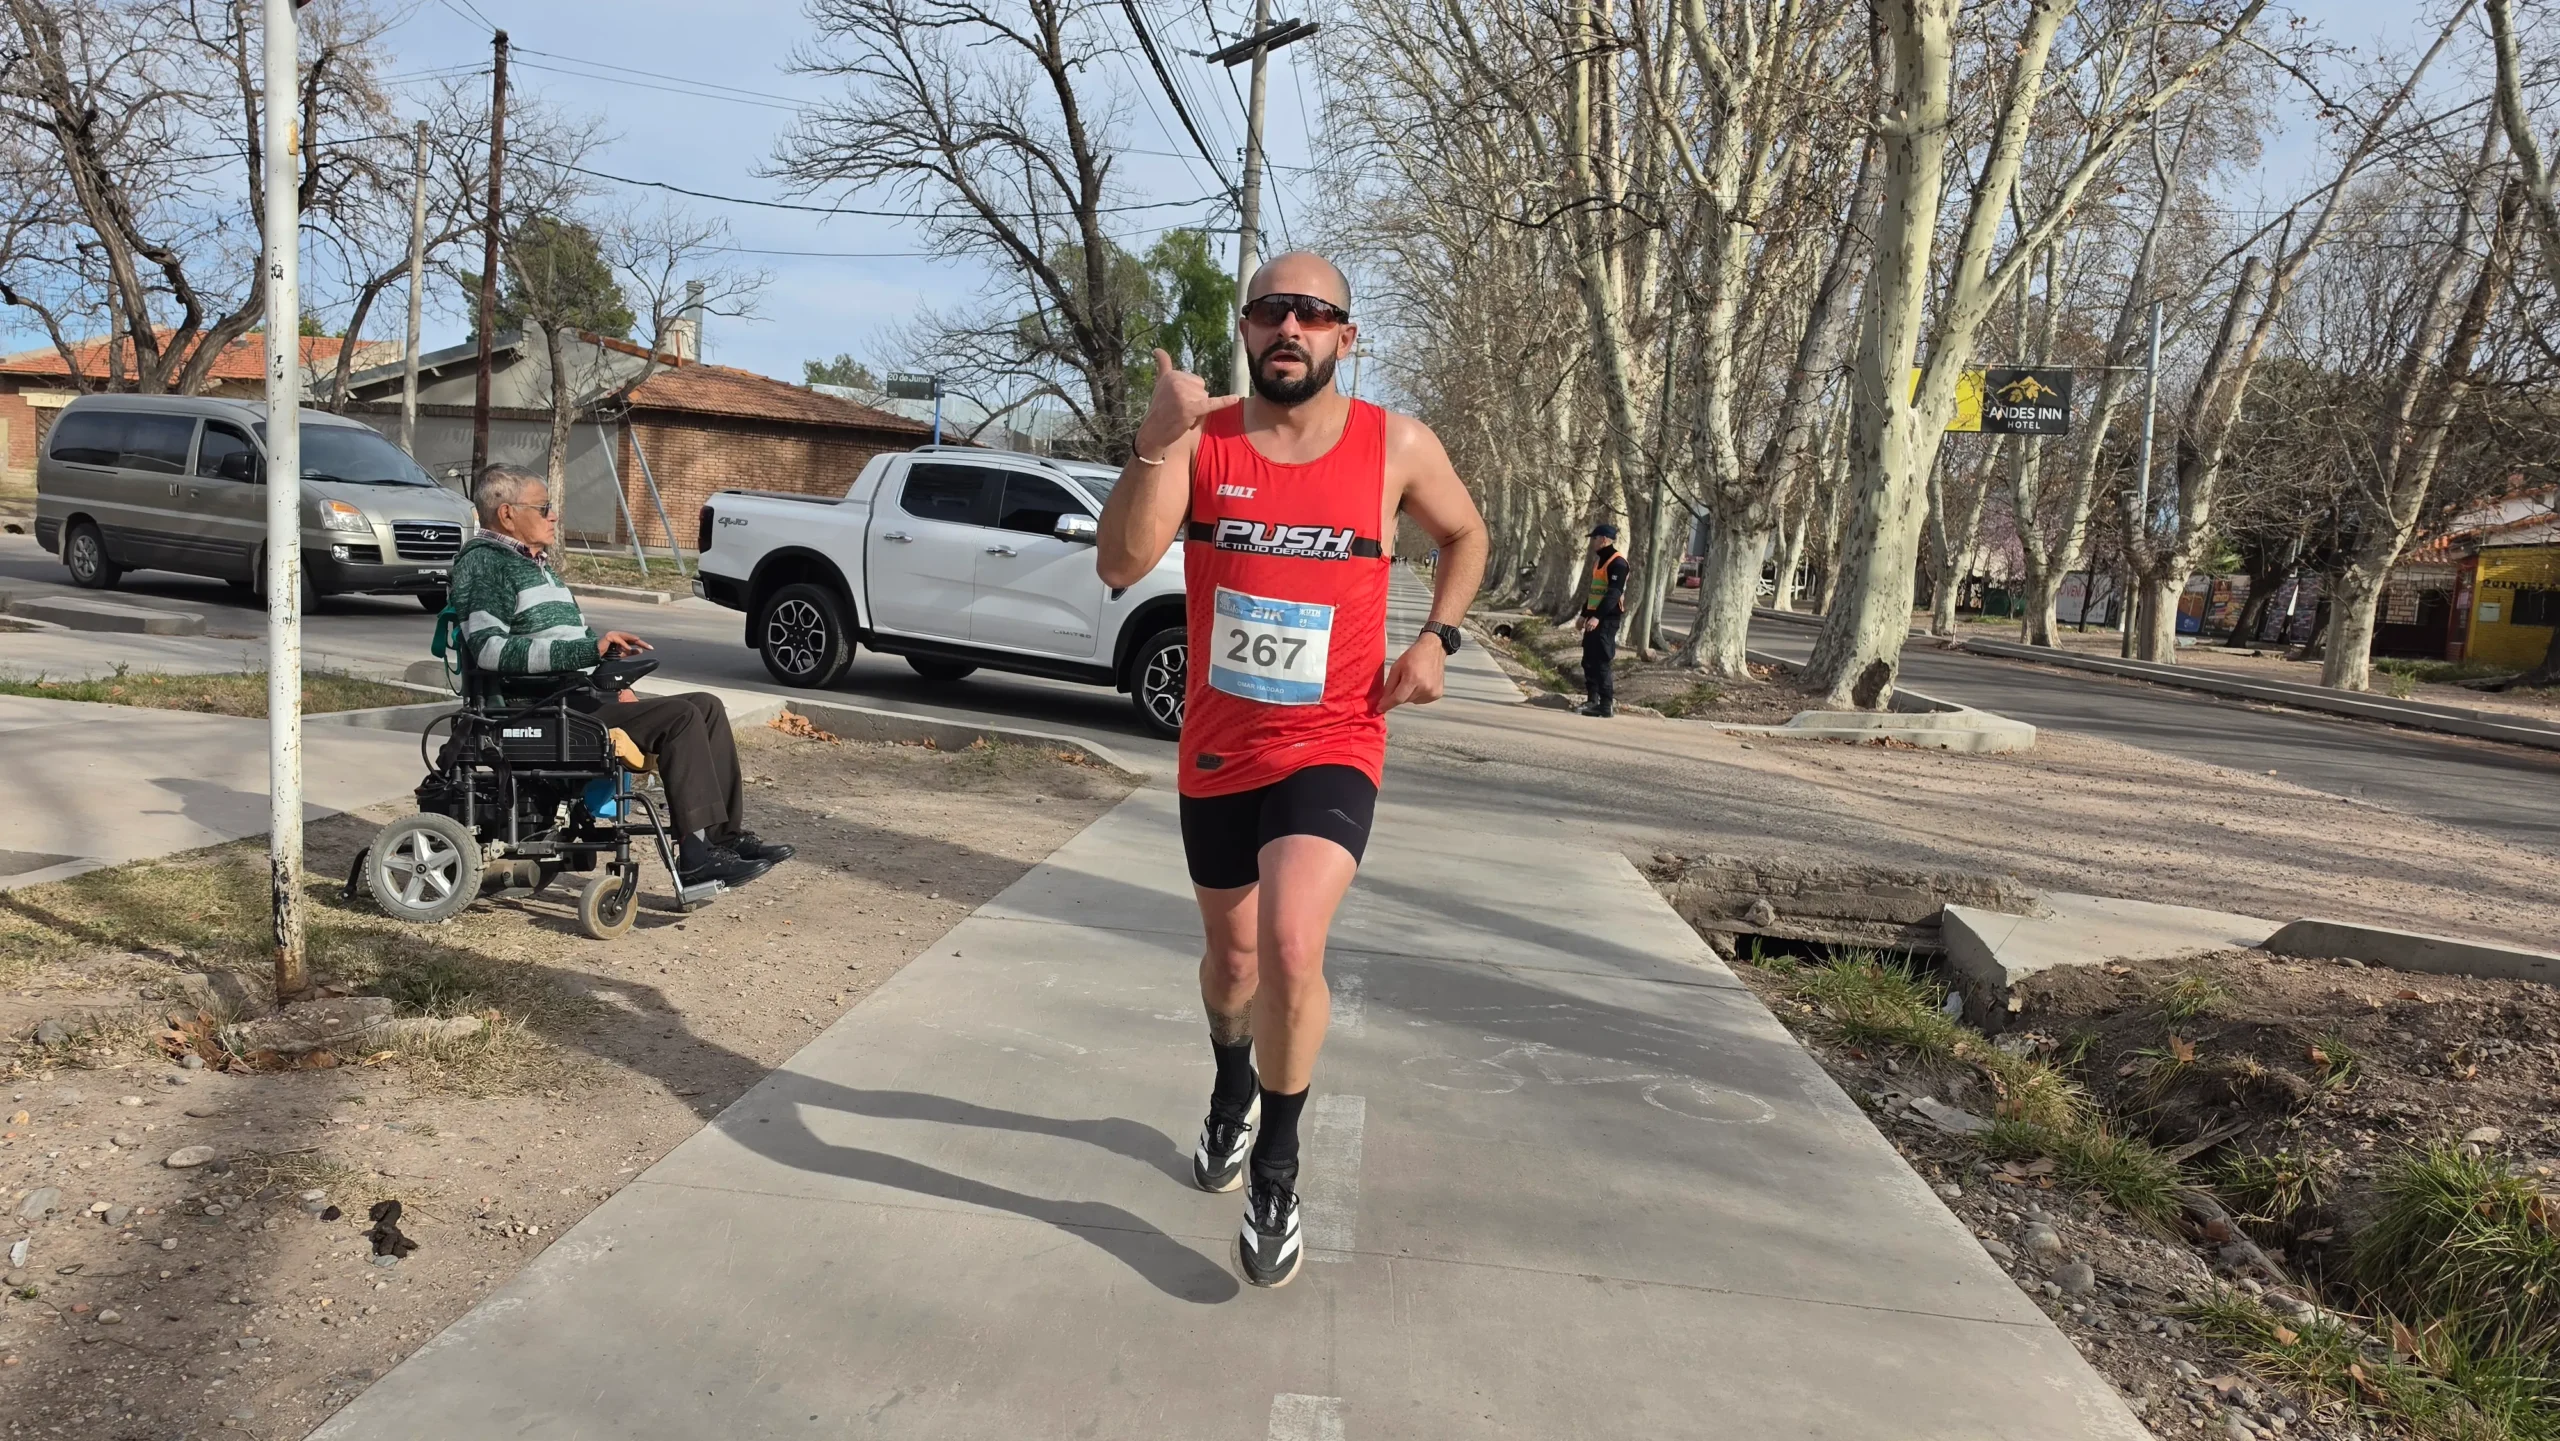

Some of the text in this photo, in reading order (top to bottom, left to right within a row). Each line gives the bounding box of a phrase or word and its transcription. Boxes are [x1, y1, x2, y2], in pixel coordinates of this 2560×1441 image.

[888, 373, 930, 383] 20 de Junio
[1989, 406, 2035, 420] ANDES
[2038, 407, 2062, 421] INN
[2007, 421, 2041, 429] HOTEL
[718, 517, 748, 527] 4WD
[1216, 520, 1353, 552] PUSH
[1216, 541, 1349, 559] ACTITUD DEPORTIVA
[1250, 606, 1283, 621] 21K
[1053, 630, 1092, 638] LIMITED
[1227, 629, 1307, 669] 267
[1237, 681, 1285, 693] OMAR HADDAD
[503, 727, 542, 737] merits
